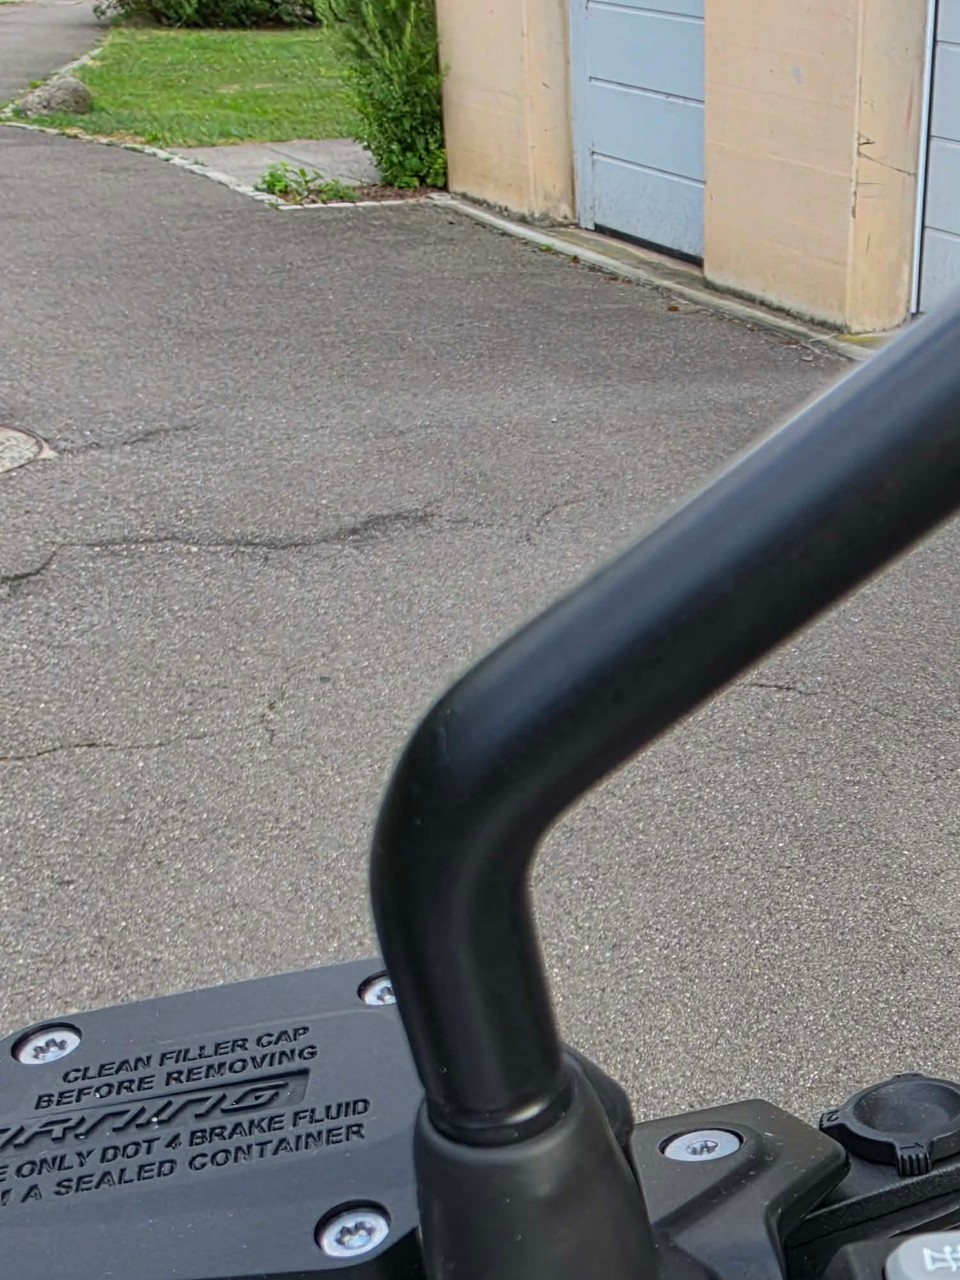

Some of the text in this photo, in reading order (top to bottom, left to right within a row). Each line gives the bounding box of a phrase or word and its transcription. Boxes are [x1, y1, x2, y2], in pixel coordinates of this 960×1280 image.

[34, 1045, 318, 1110] BEFORE REMOVING
[62, 1027, 310, 1083] CLEAN FILLER CAP
[15, 1148, 96, 1178] ONLY
[100, 1137, 161, 1164] DOT
[165, 1132, 182, 1150] 4
[188, 1112, 285, 1147] BRAKE
[292, 1098, 371, 1128] FLUID
[20, 1183, 42, 1203] A
[53, 1159, 178, 1196] SEALED
[188, 1123, 366, 1171] CONTAINER
